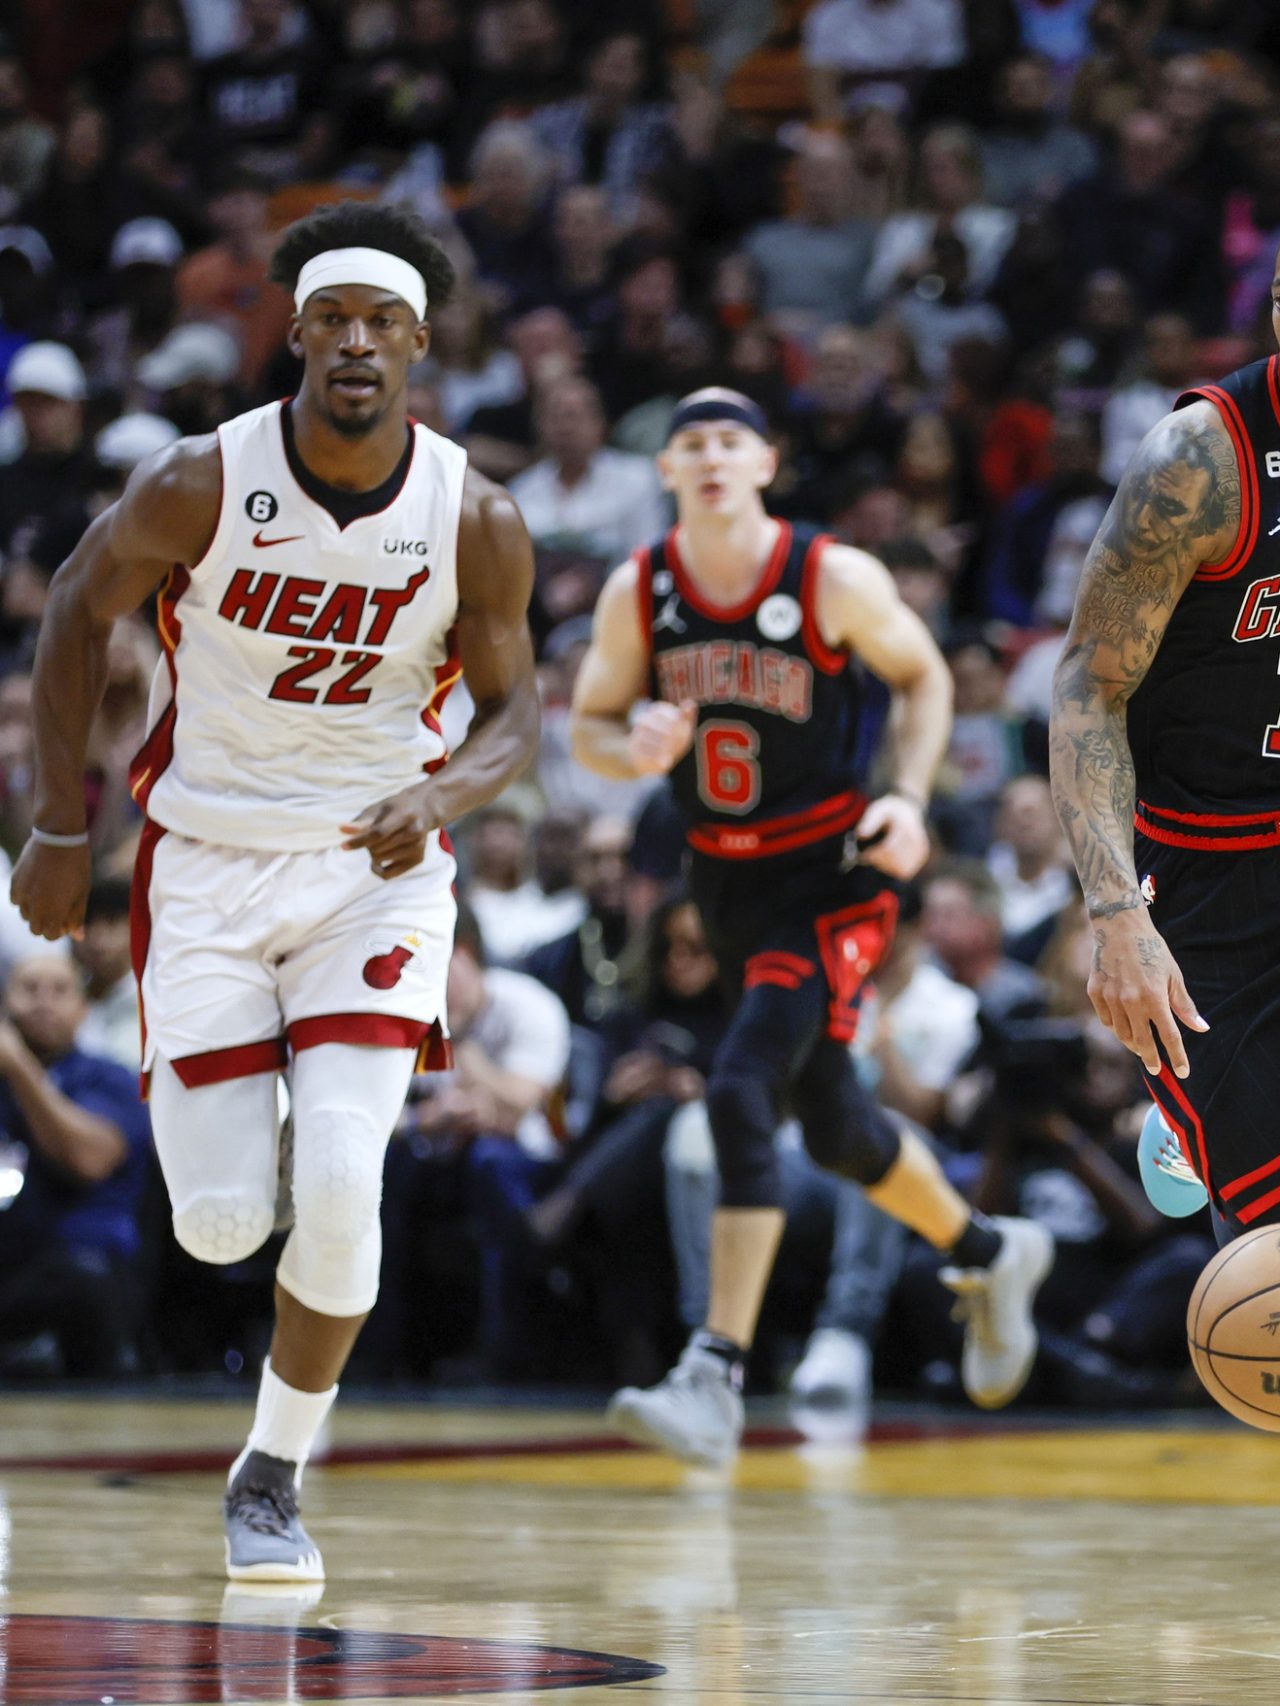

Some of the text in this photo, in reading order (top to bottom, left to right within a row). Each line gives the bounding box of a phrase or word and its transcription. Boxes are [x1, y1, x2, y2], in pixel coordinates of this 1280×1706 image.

[253, 495, 272, 520] 6
[383, 537, 428, 556] UKG
[218, 565, 431, 646] HEAT
[268, 646, 383, 704] 22
[695, 718, 762, 815] 6
